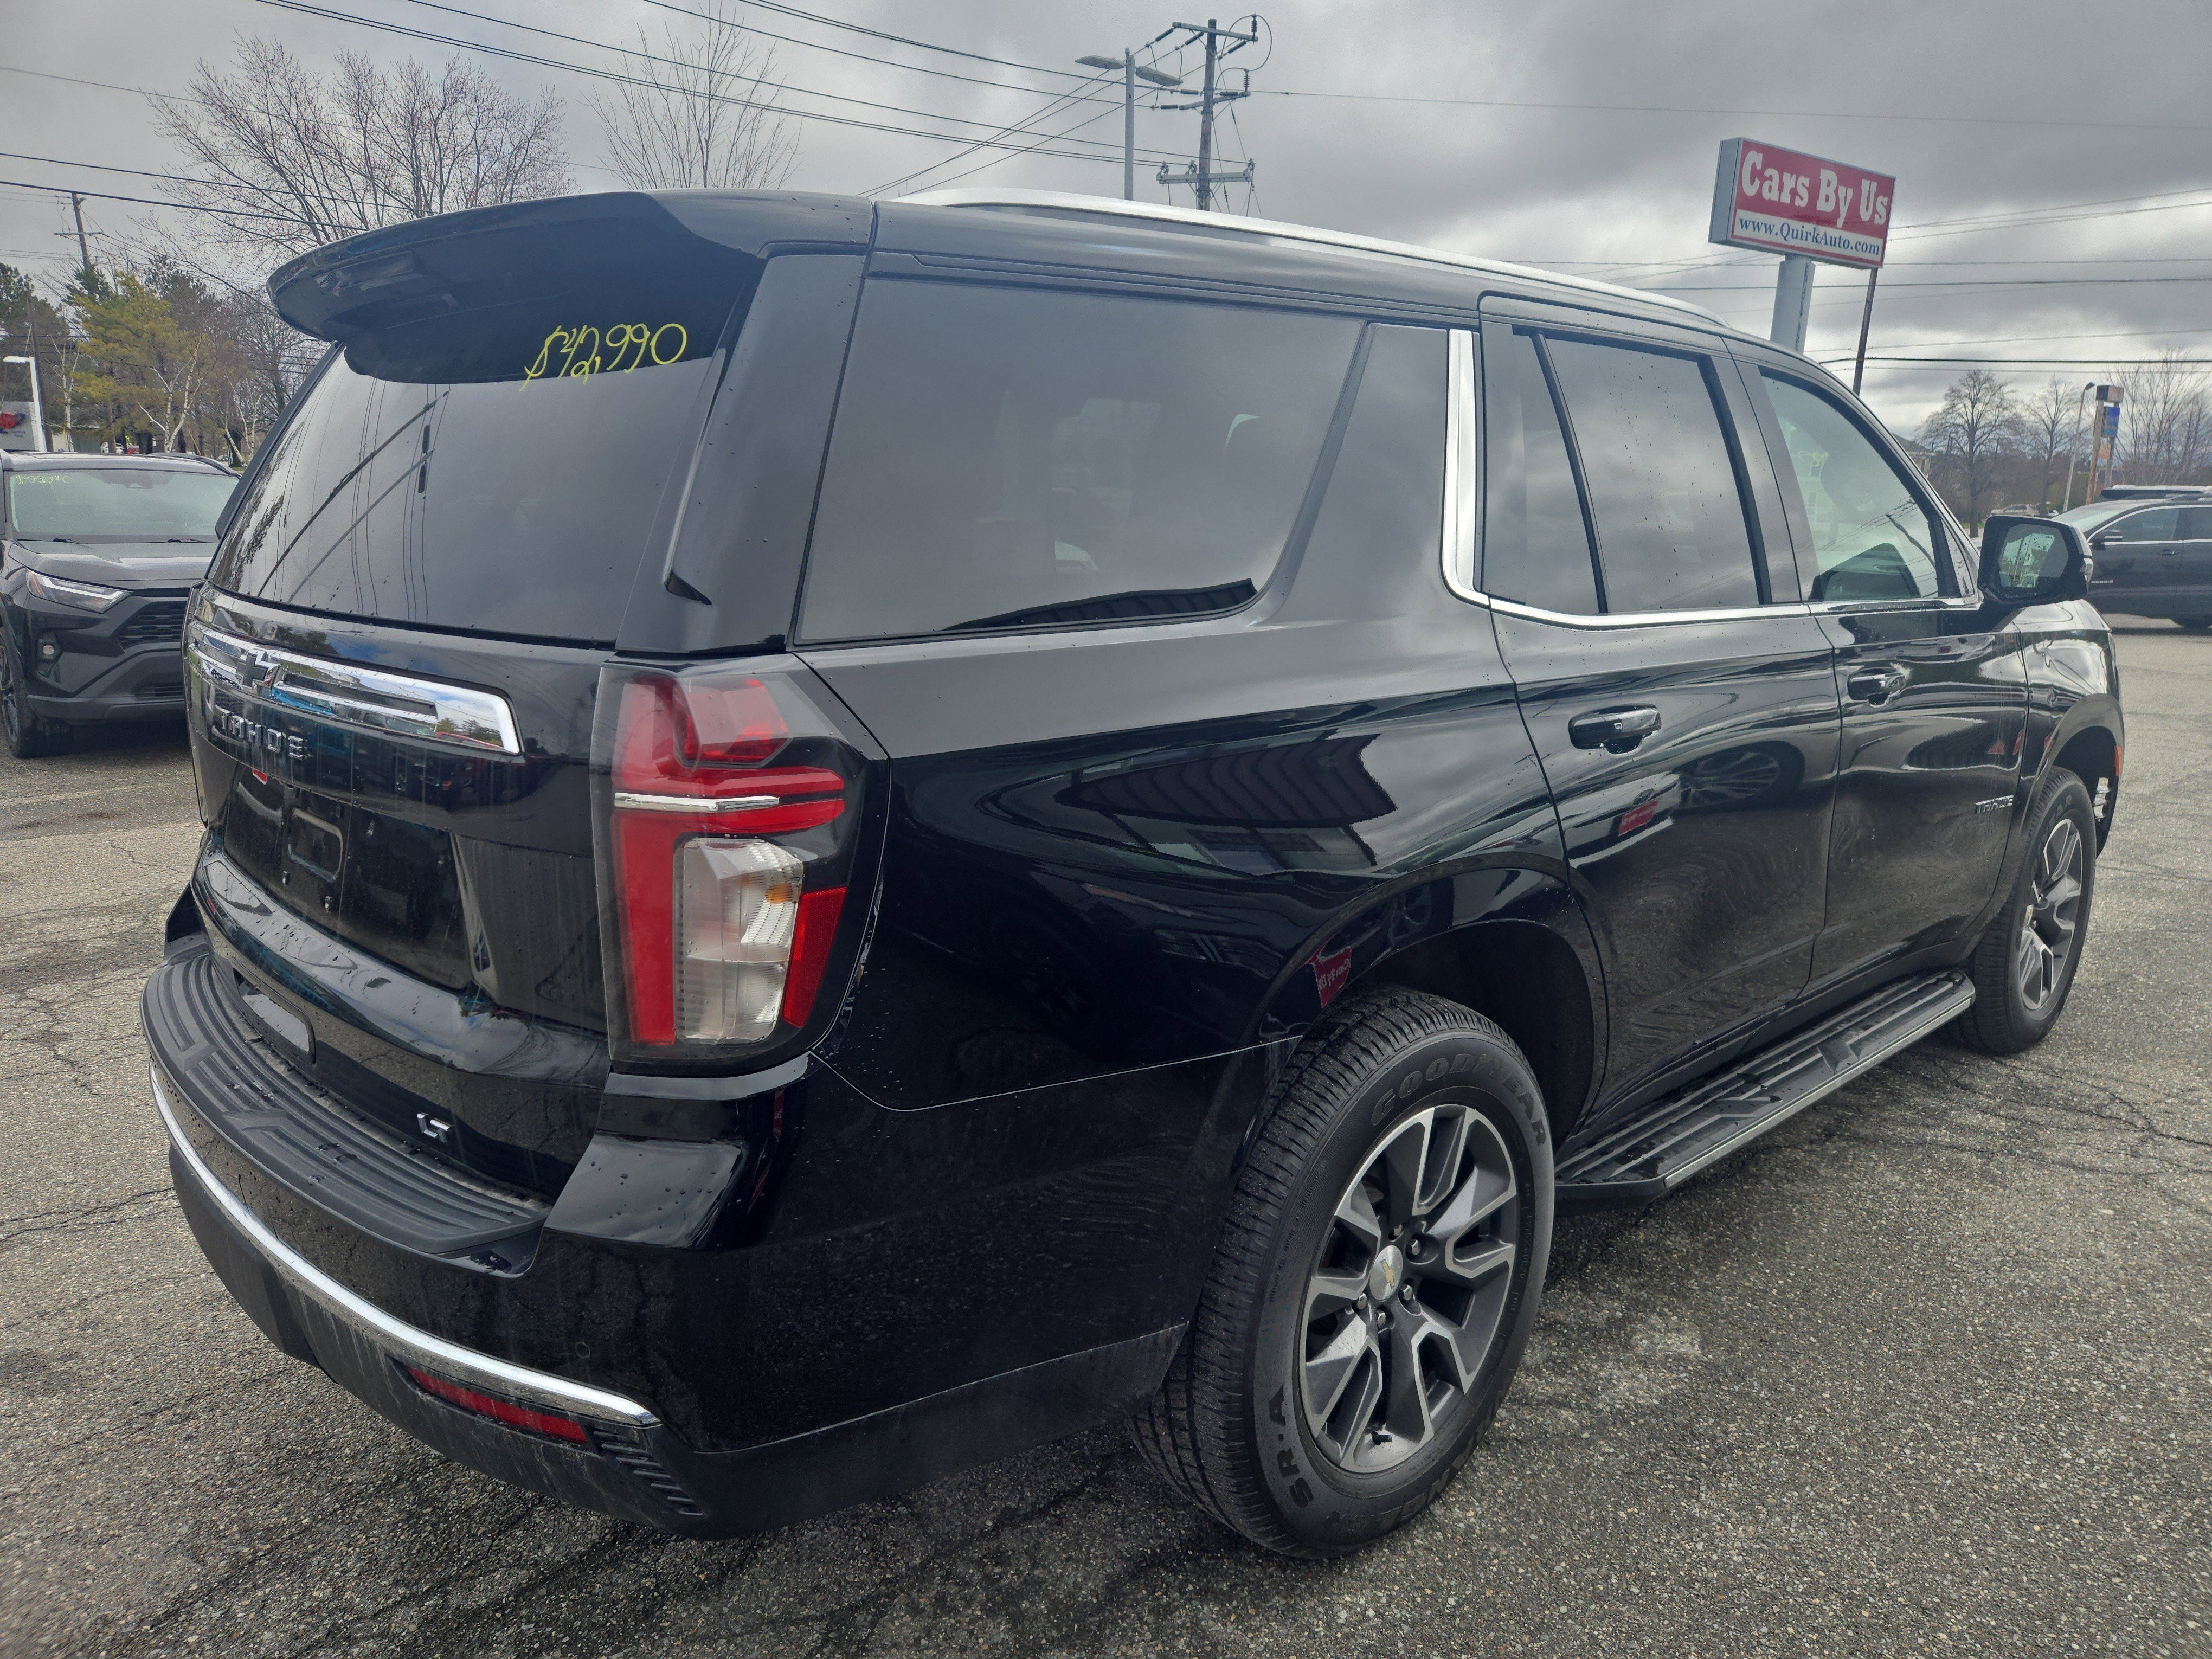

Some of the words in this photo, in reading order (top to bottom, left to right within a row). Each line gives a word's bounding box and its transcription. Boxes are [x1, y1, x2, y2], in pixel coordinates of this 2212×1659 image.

[1741, 150, 1810, 208] Cars
[1816, 168, 1854, 228] By
[1860, 178, 1888, 226] Us
[1739, 217, 1880, 256] www.QuirkAuto.com
[519, 323, 687, 391] $42,990
[216, 706, 304, 759] TAHOE
[416, 1111, 453, 1143] LT
[1371, 1053, 1547, 1146] GOODYEAR
